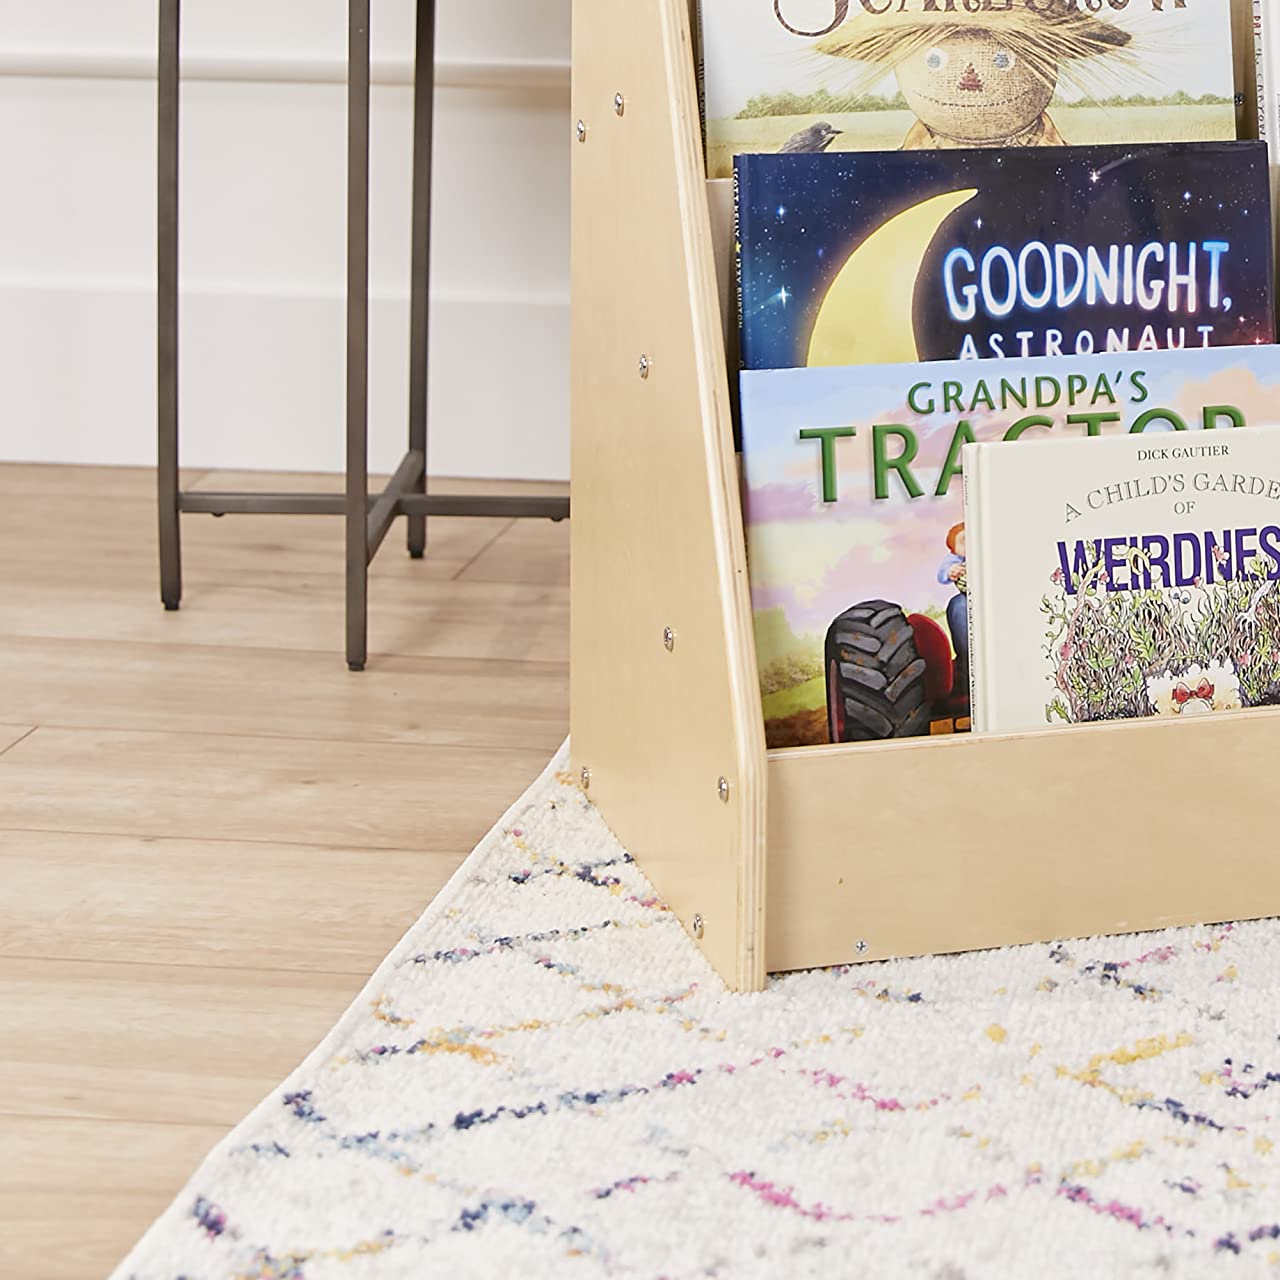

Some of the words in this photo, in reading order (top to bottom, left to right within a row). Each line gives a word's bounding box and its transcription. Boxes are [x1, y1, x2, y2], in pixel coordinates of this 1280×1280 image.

[944, 240, 1232, 320] GOODNIGHT,
[960, 324, 1214, 360] ASTRONAUT
[907, 371, 1149, 416] GRANDPA'S
[1138, 449, 1169, 461] DICK
[1172, 445, 1229, 460] GAUTIER
[1063, 502, 1082, 524] A
[1087, 473, 1185, 510] CHILD'S
[1173, 501, 1196, 515] OF
